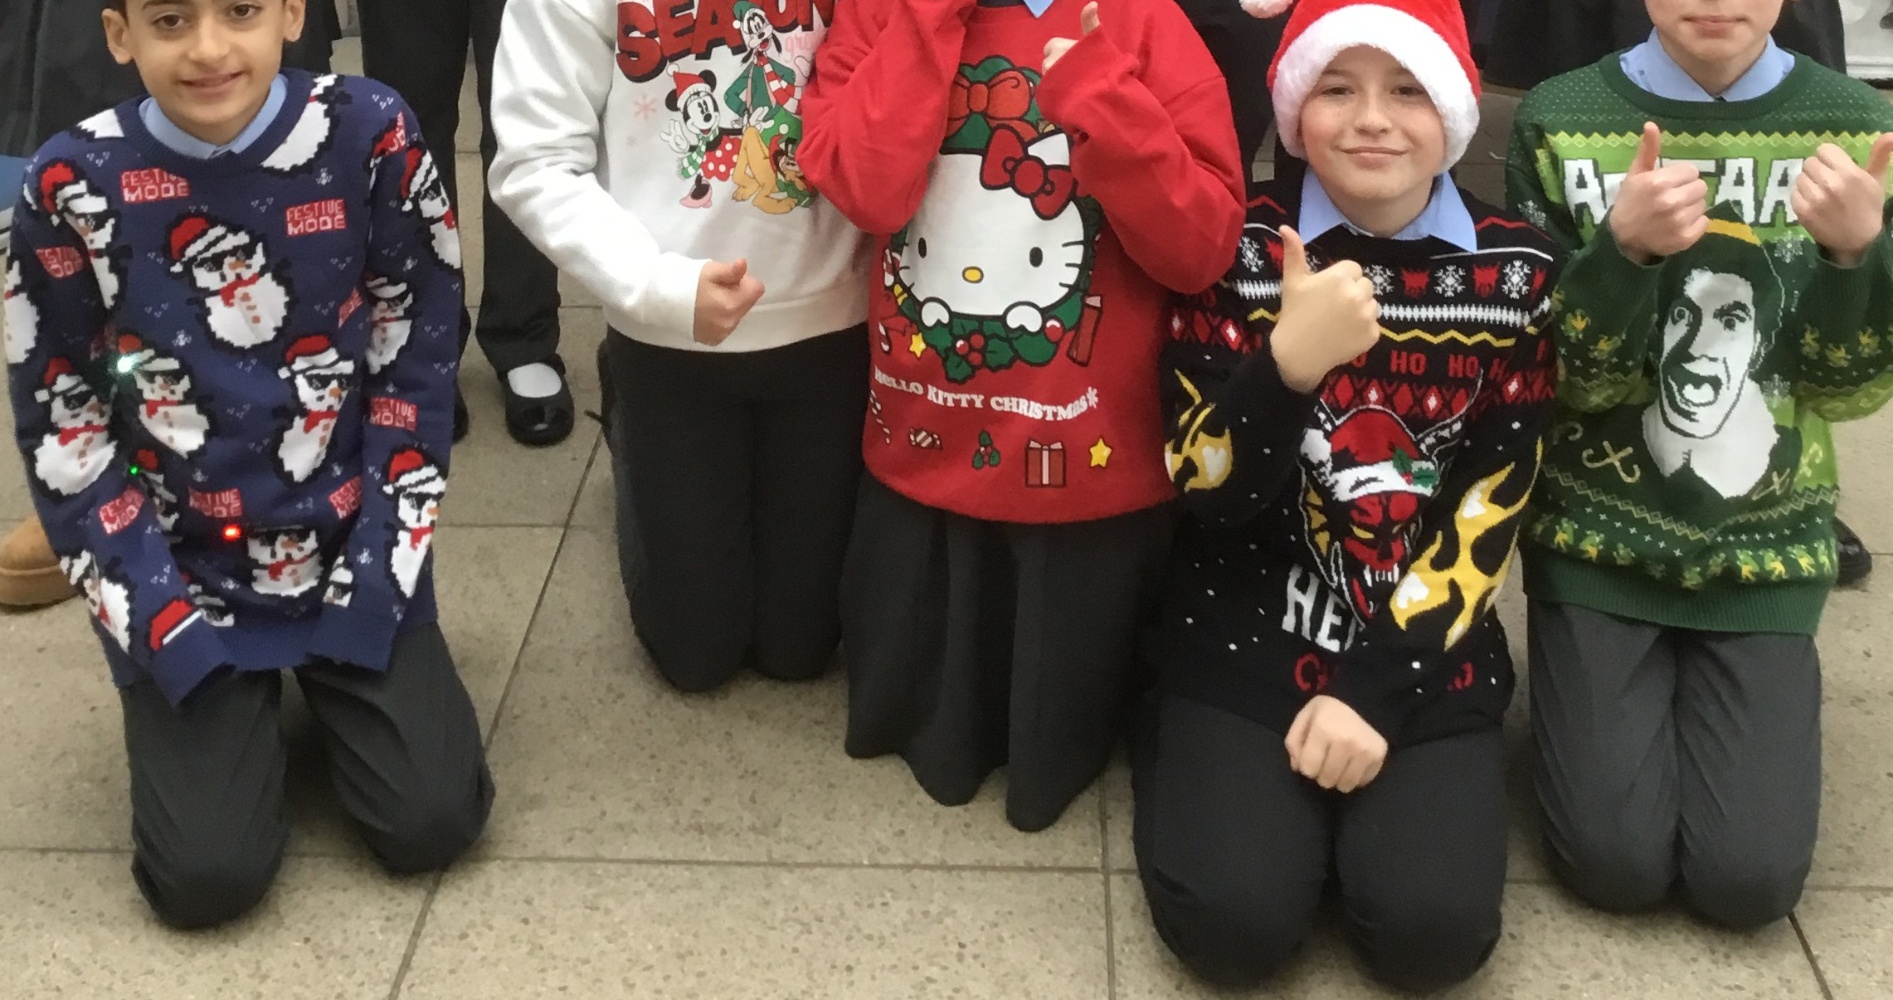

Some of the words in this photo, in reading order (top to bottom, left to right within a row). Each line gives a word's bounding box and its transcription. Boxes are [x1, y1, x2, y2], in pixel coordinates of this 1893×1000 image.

[123, 181, 189, 202] MODE
[286, 199, 345, 222] FESTIVE
[287, 214, 346, 236] MODE
[1390, 350, 1427, 375] HO
[1448, 354, 1480, 379] HO
[874, 364, 925, 396] HELLO
[927, 383, 985, 409] KITTY
[990, 395, 1089, 421] CHRISTMAS
